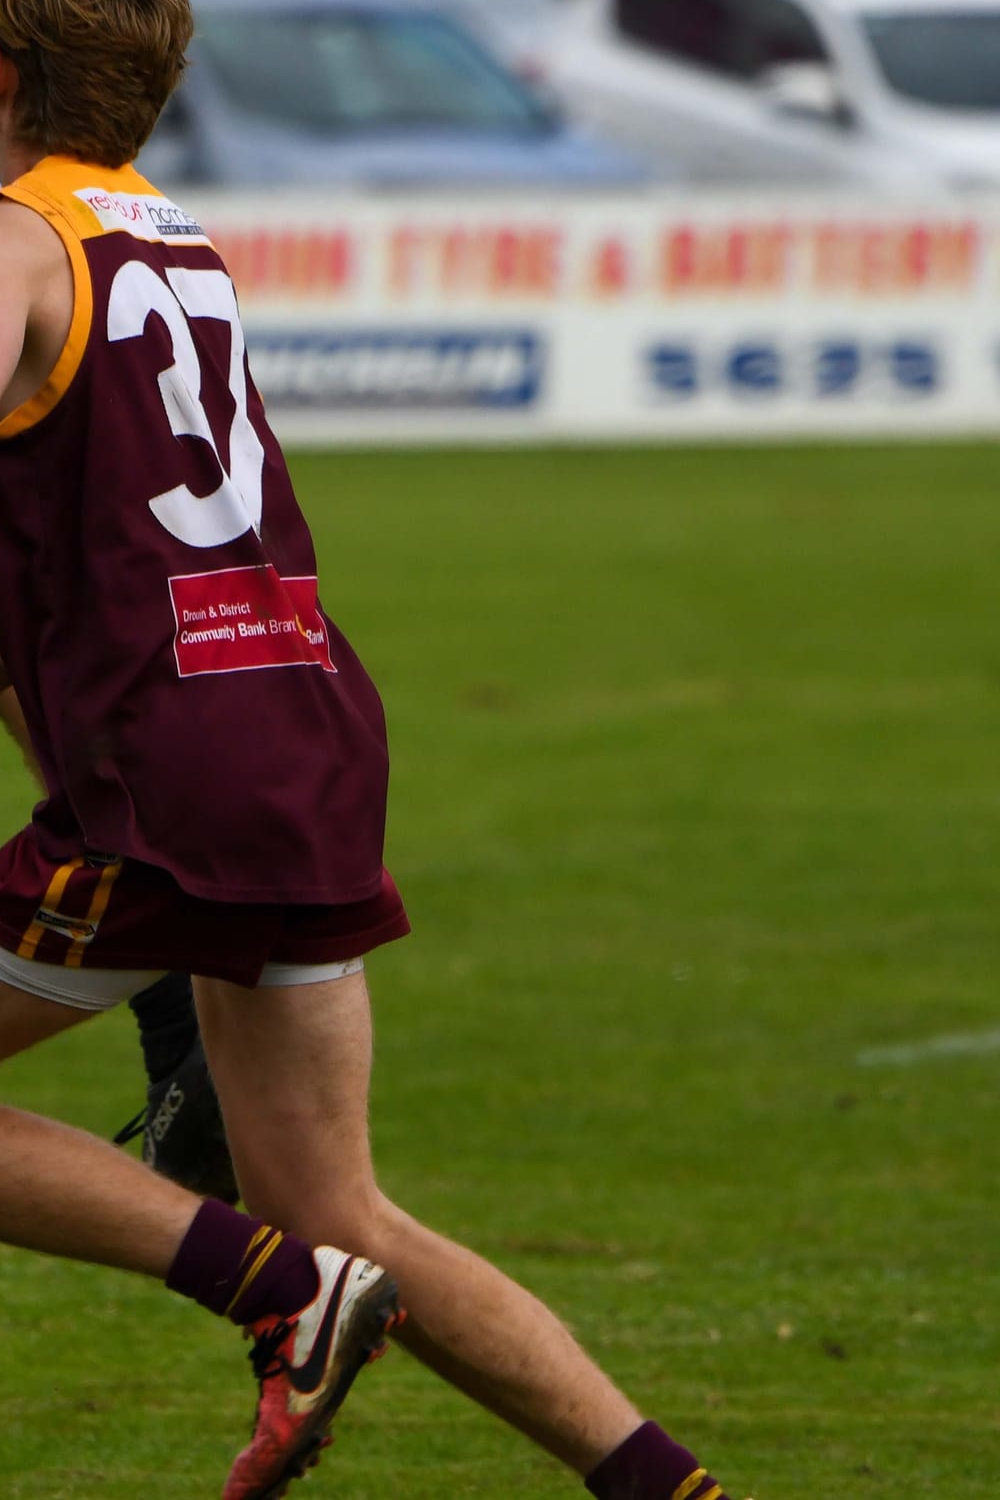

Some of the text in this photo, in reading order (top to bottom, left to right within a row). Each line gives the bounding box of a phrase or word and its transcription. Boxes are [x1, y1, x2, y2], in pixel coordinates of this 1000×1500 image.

[107, 259, 264, 549] 37
[208, 605, 218, 619] &
[218, 601, 251, 617] District
[180, 624, 236, 645] Community
[237, 621, 267, 637] Bank
